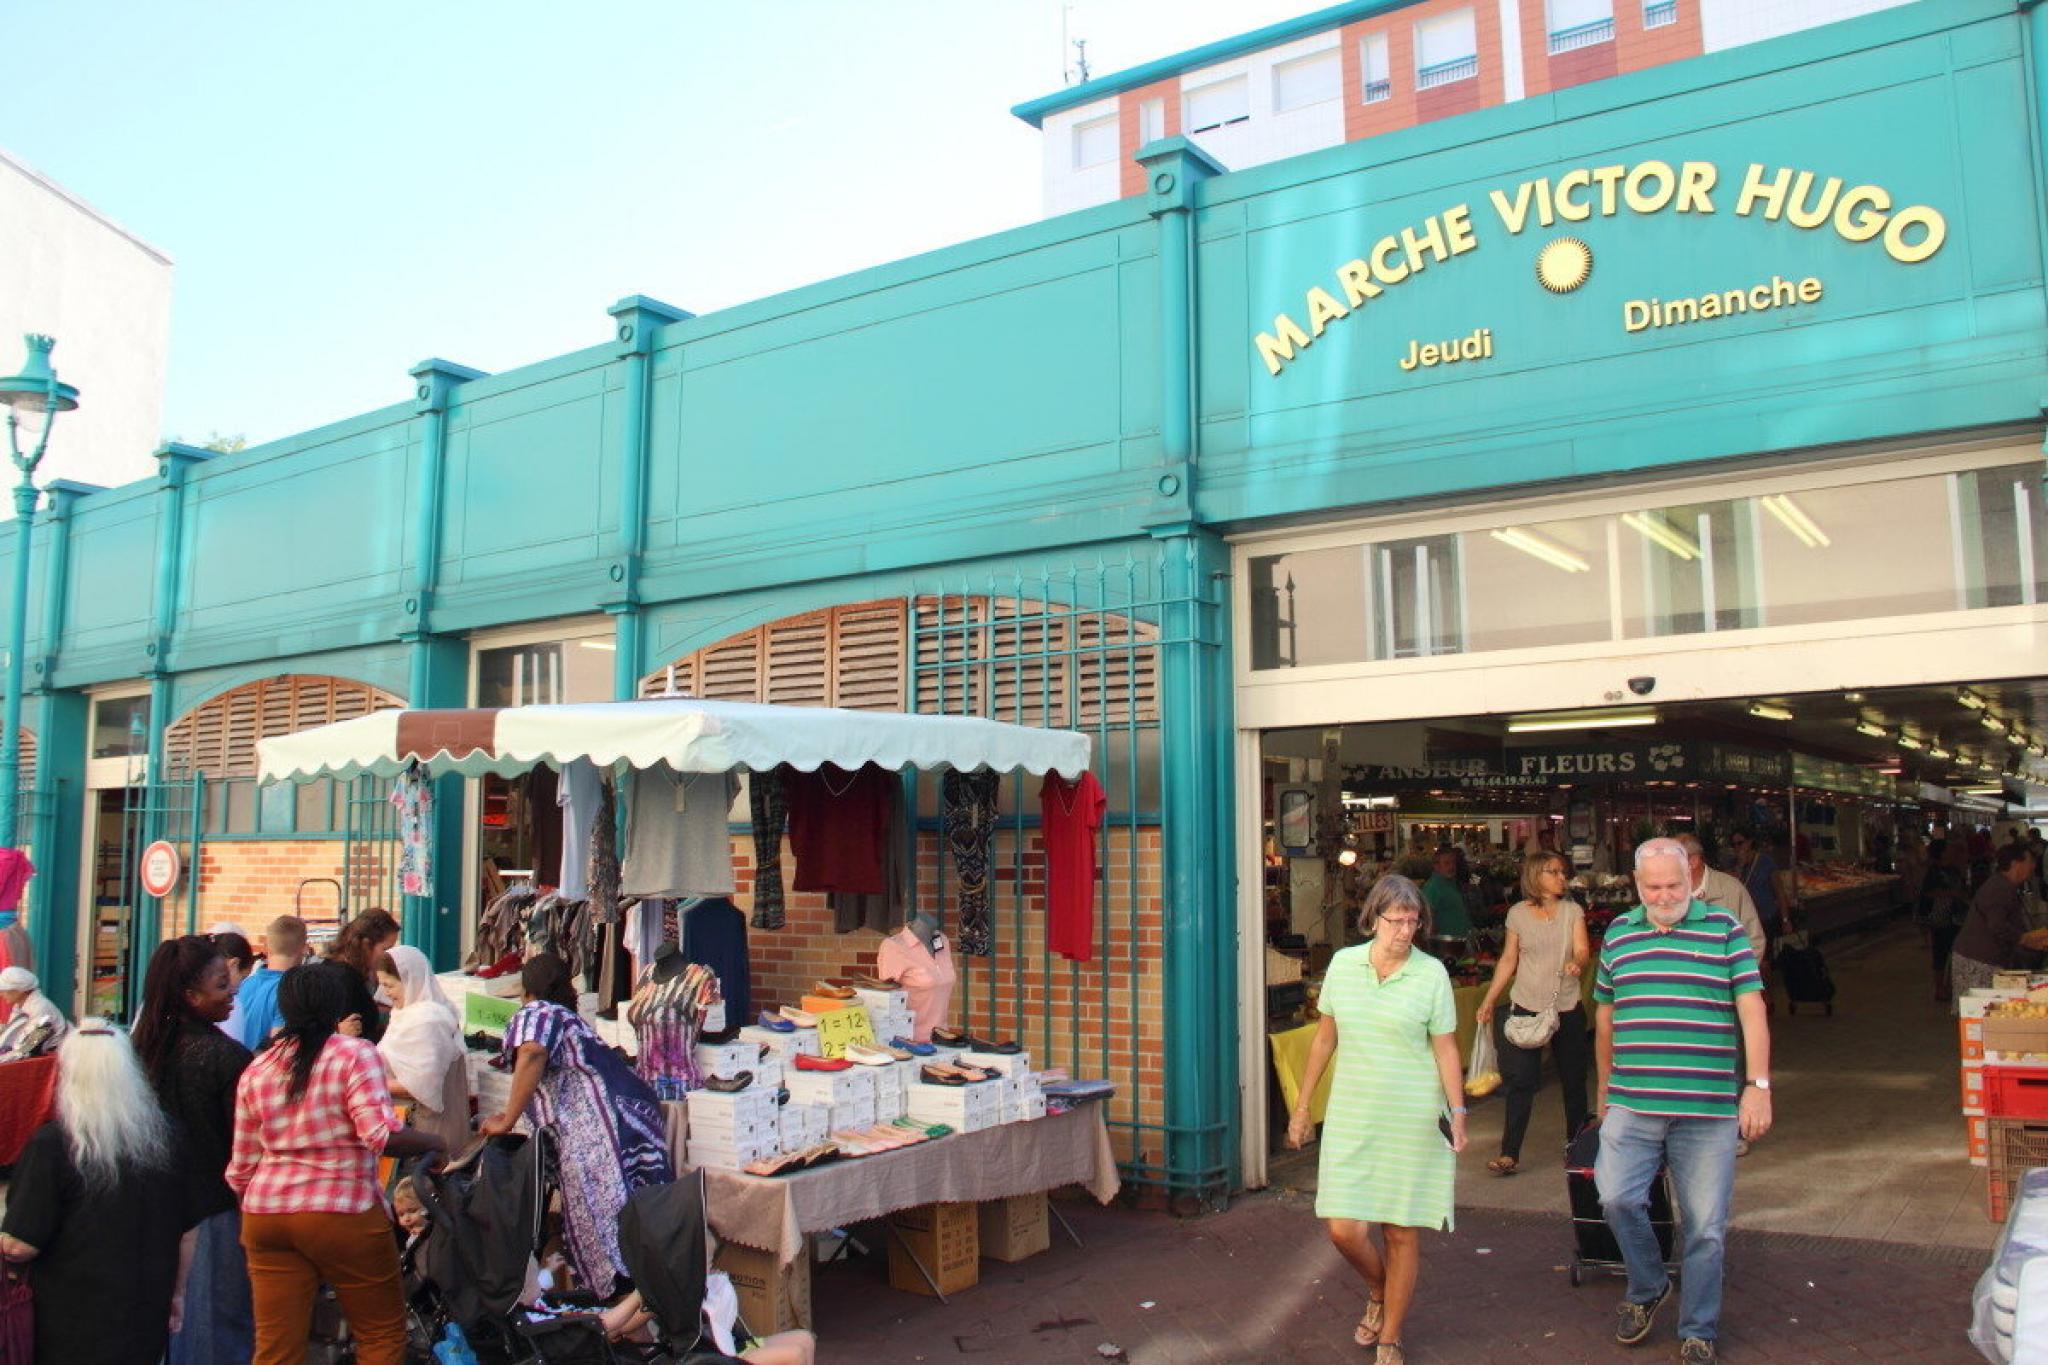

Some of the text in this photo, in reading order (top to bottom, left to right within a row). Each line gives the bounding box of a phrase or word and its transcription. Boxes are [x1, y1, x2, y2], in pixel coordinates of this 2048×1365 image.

[1255, 160, 1947, 375] MARCHE VICTOR HUGO
[1399, 275, 1824, 371] Jeudi Dimanche
[1520, 752, 1636, 775] FLEURS
